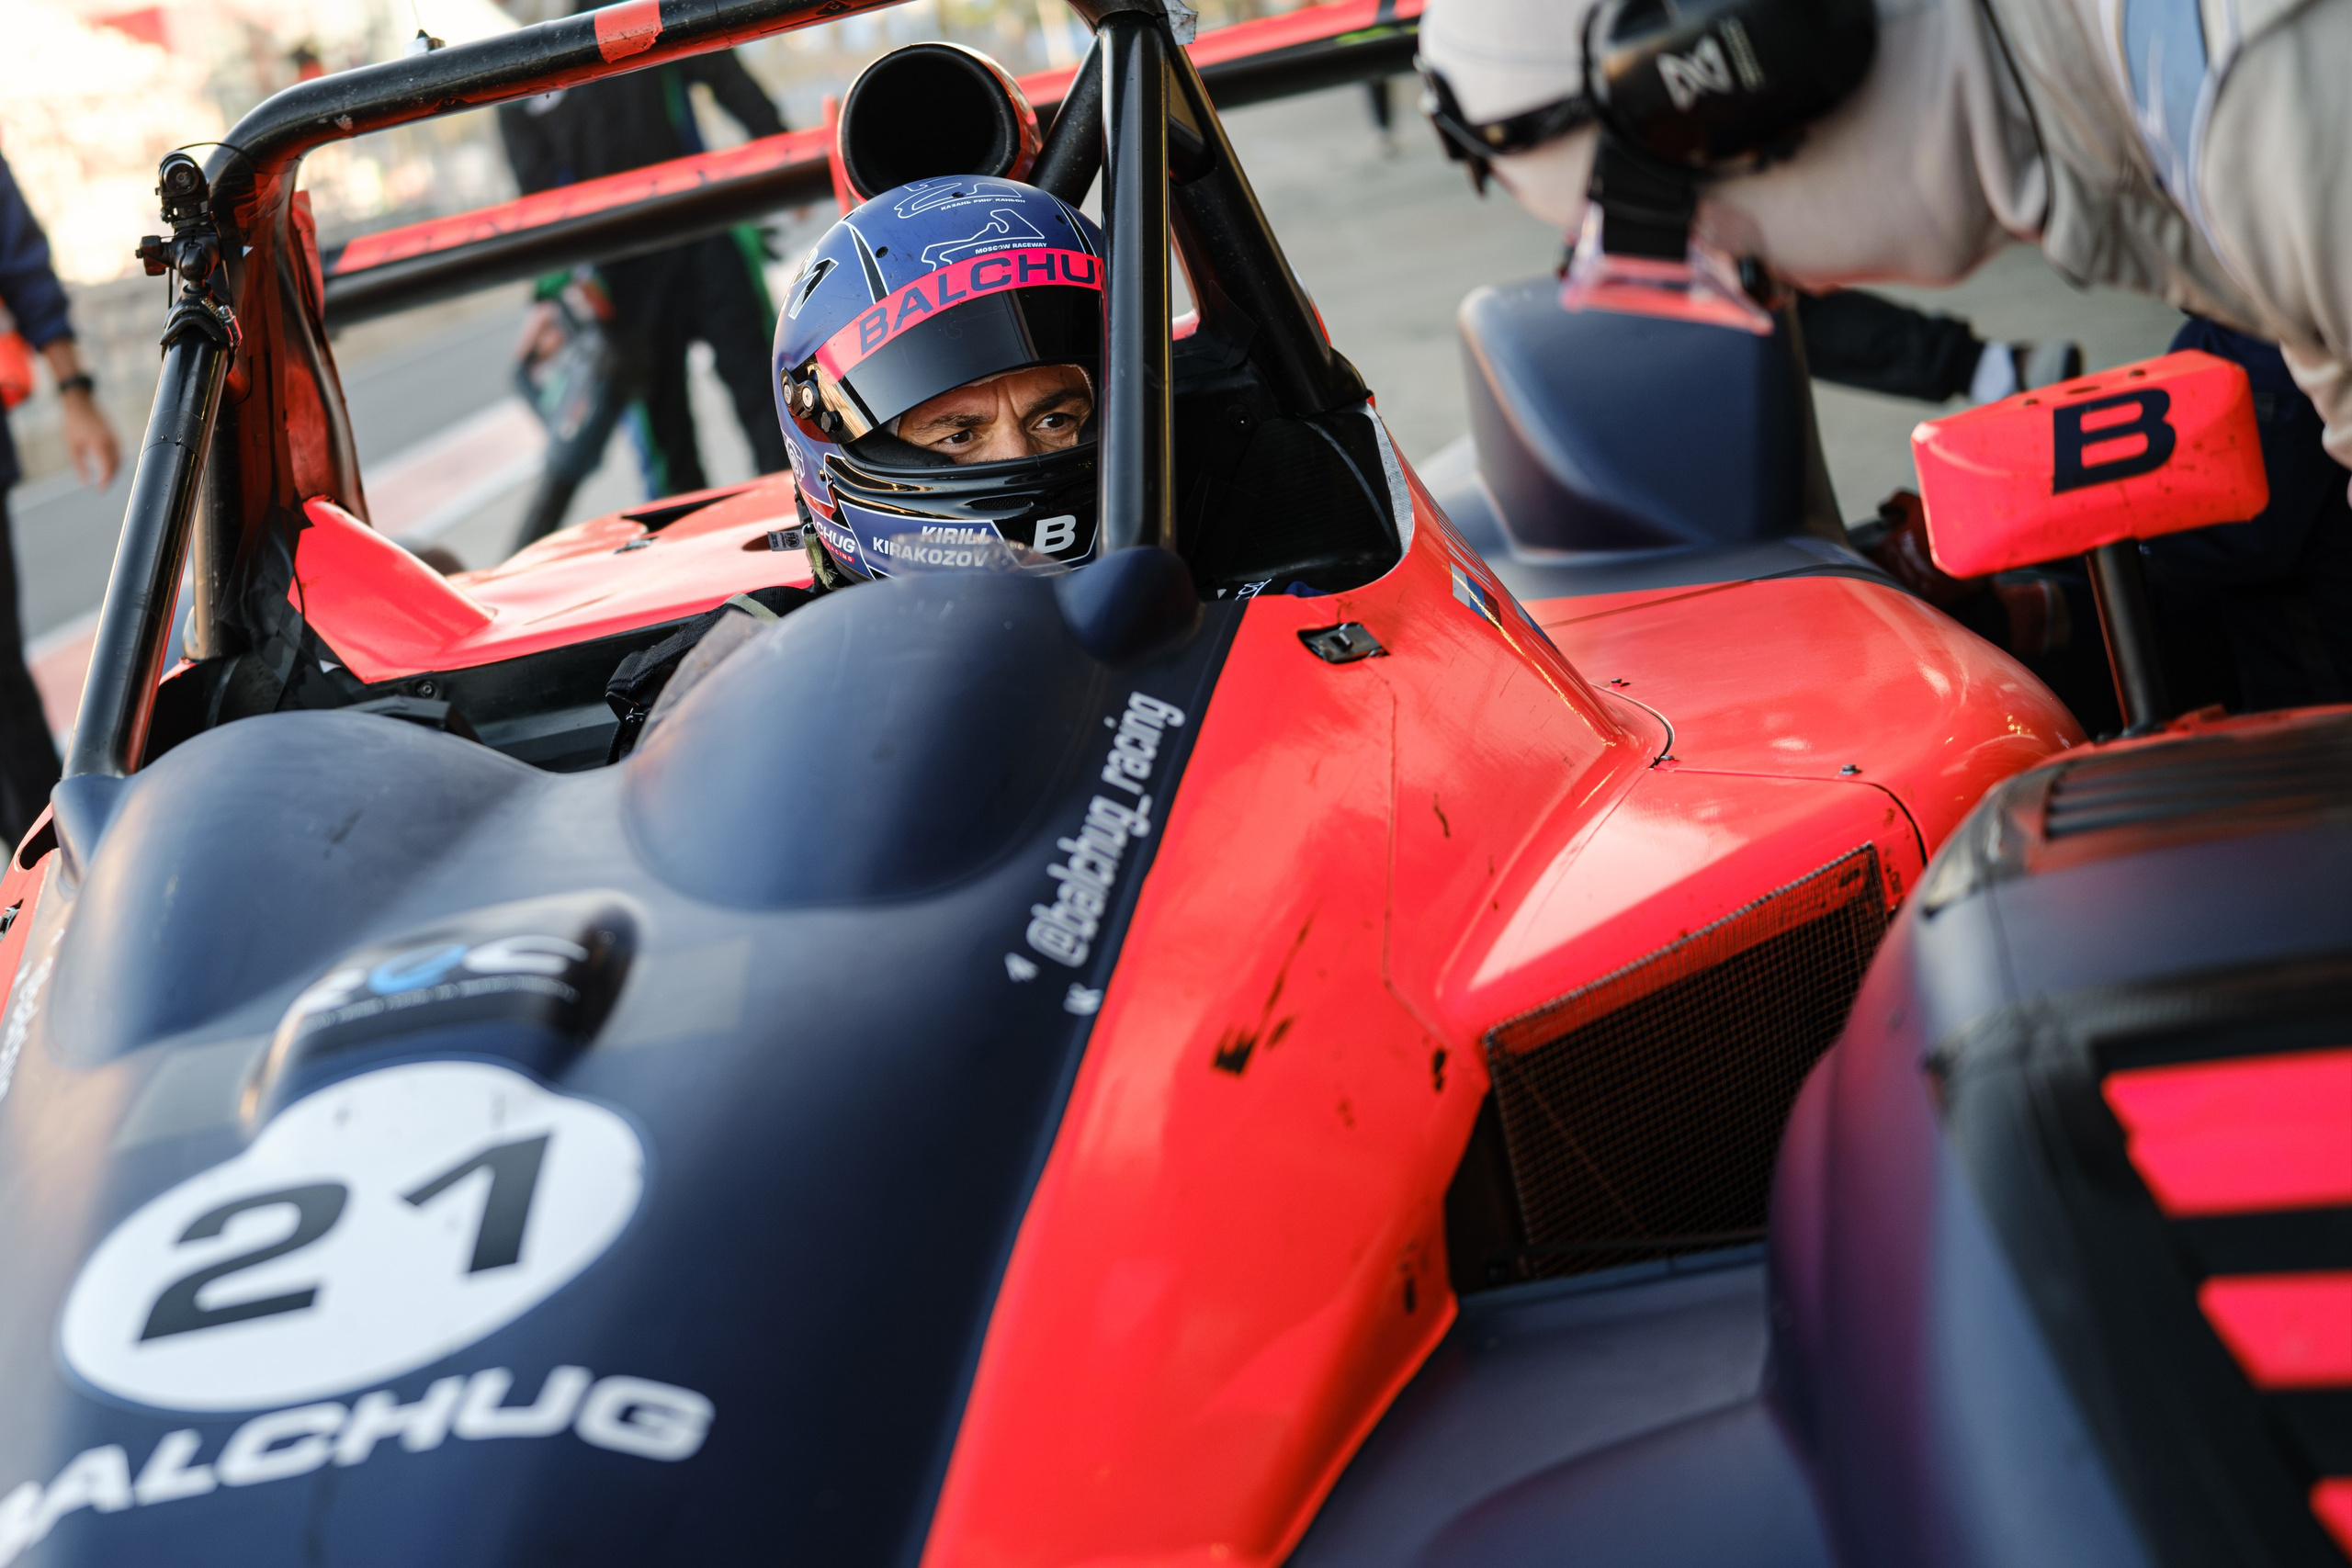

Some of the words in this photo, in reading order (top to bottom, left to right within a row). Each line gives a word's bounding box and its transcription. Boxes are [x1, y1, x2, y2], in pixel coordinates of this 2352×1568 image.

[975, 243, 1011, 254] MOSCOW
[858, 254, 1102, 355] BALCHU
[2052, 389, 2177, 495] B
[873, 536, 989, 567] KIRAKOZOV
[921, 525, 991, 545] KIRILL
[1033, 514, 1077, 554] B
[135, 1129, 553, 1347] 21
